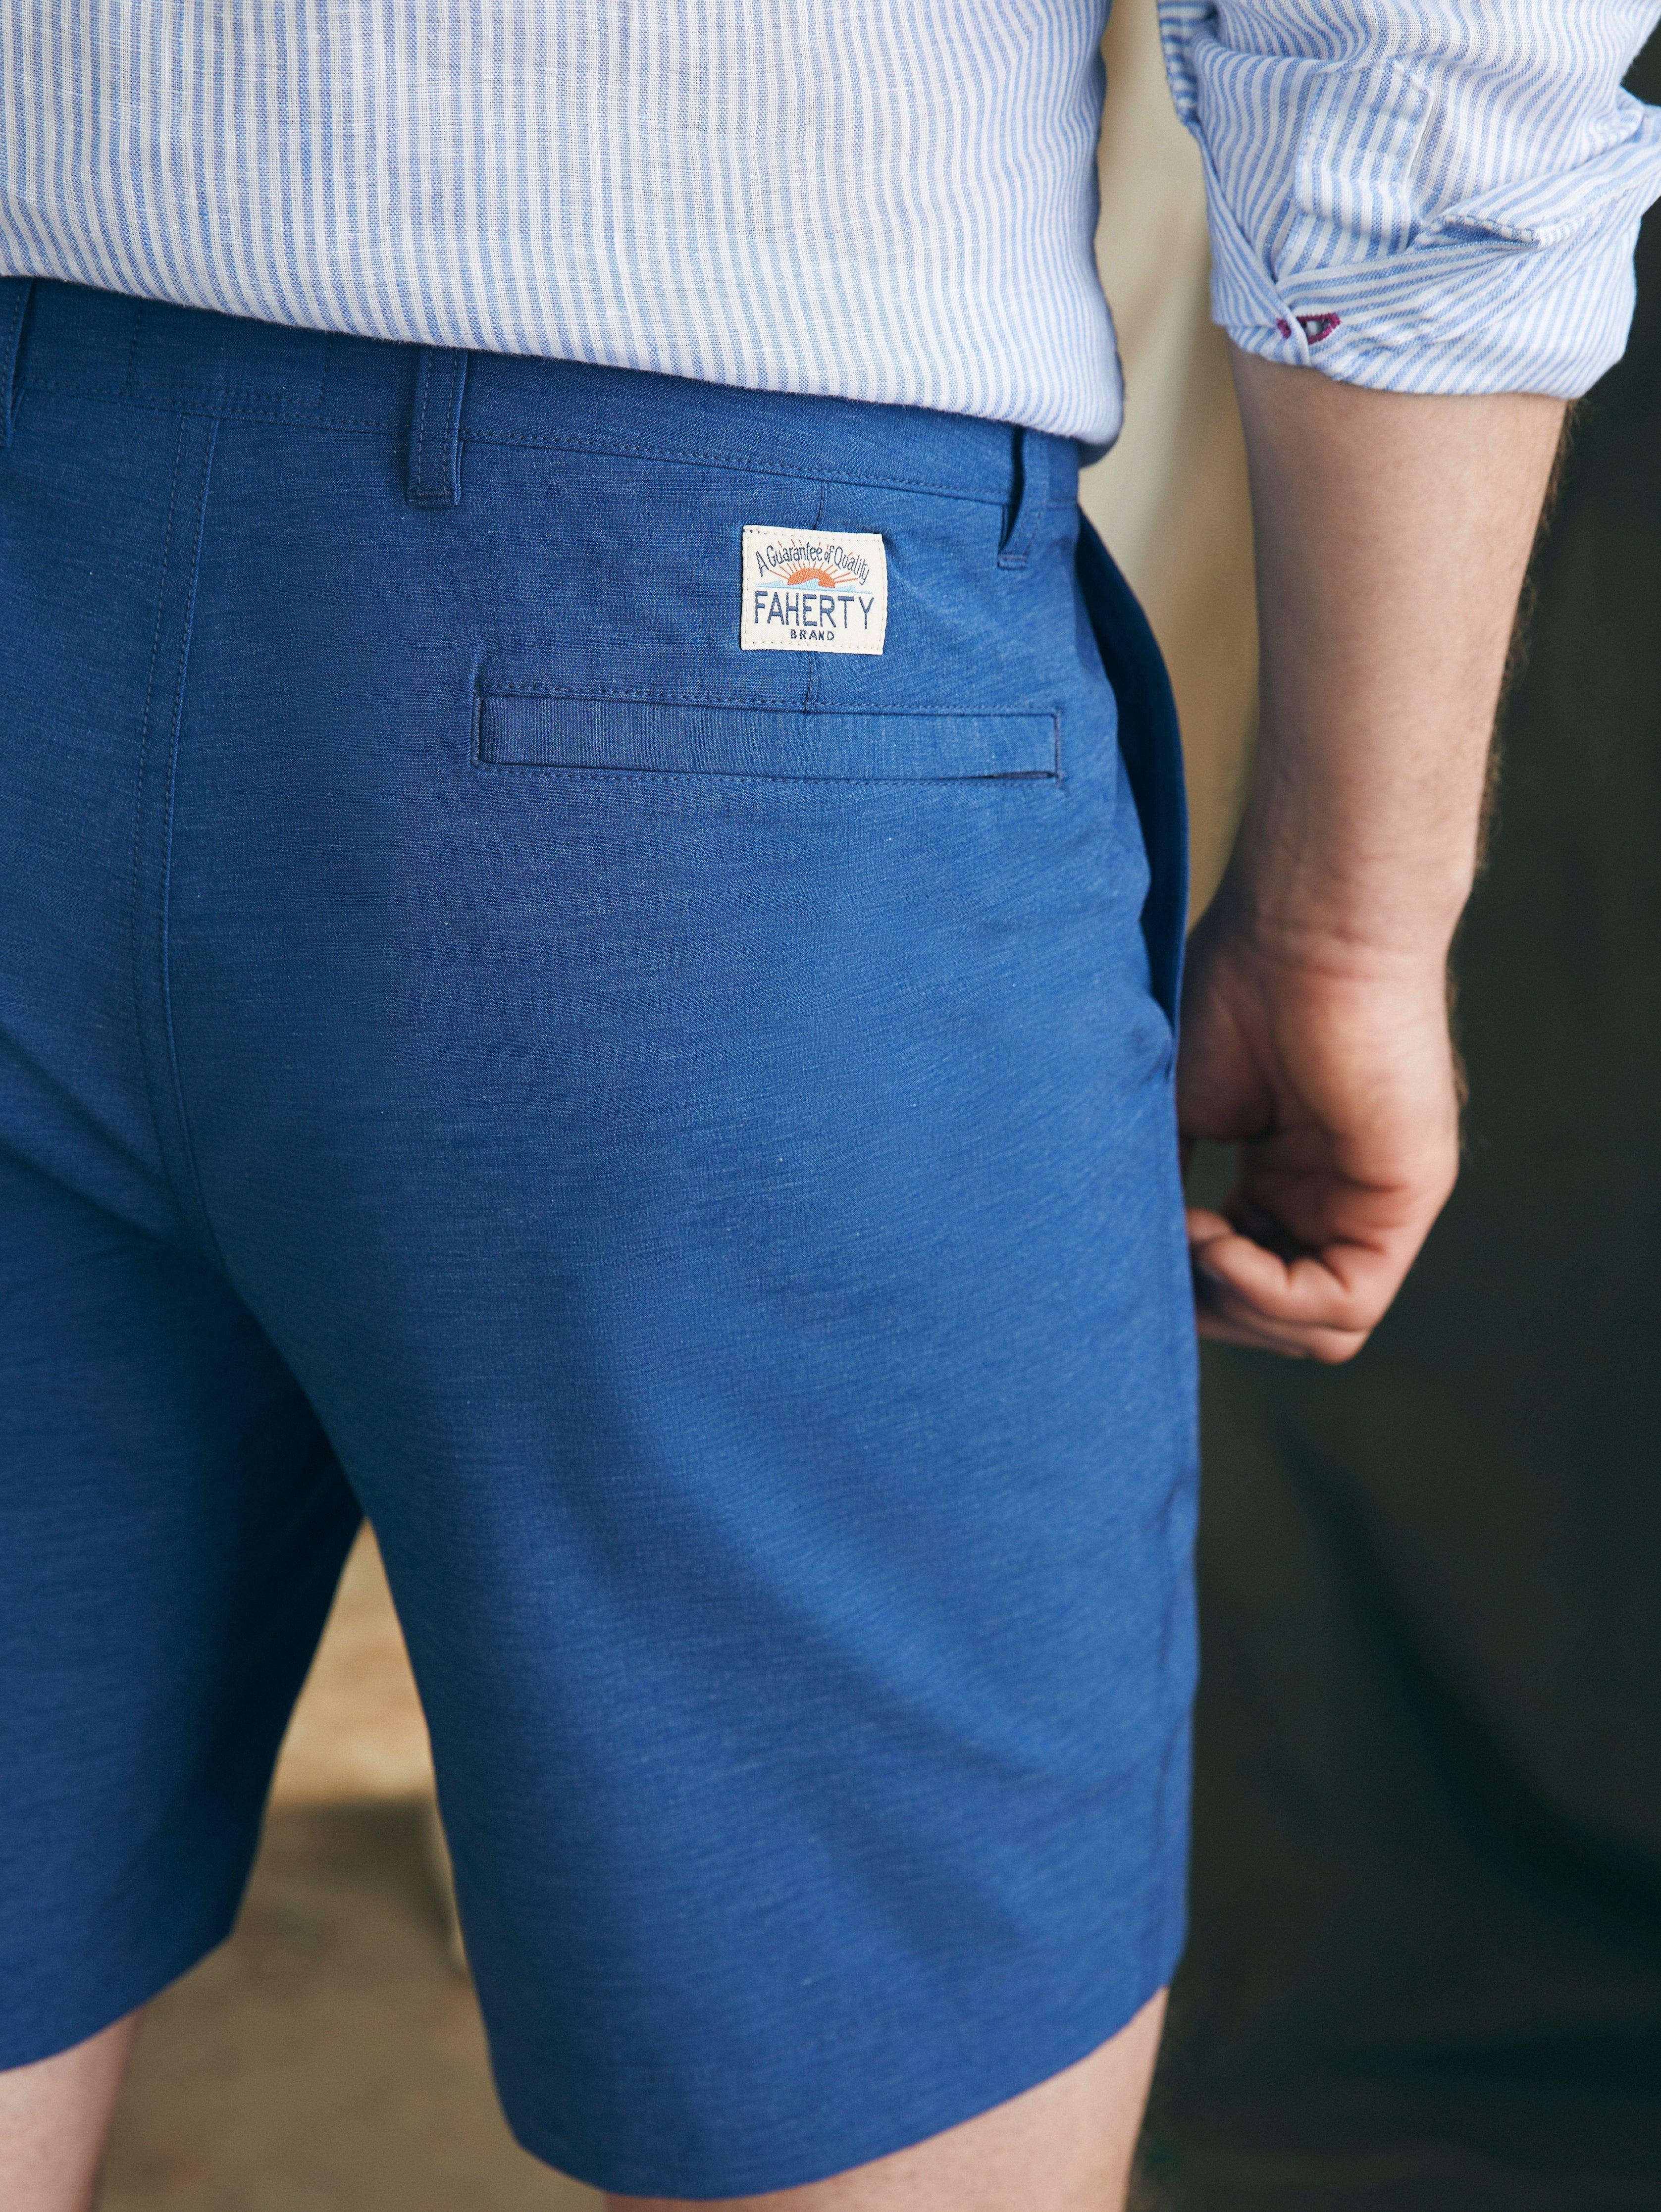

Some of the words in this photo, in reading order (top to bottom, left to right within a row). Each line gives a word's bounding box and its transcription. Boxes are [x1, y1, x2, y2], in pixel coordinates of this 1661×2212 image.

[756, 551, 769, 577] A
[767, 542, 823, 567] Guarantee
[824, 545, 834, 564] of
[834, 546, 870, 586] Quality
[755, 591, 874, 629] FAHERTY
[790, 629, 834, 641] BRAND
